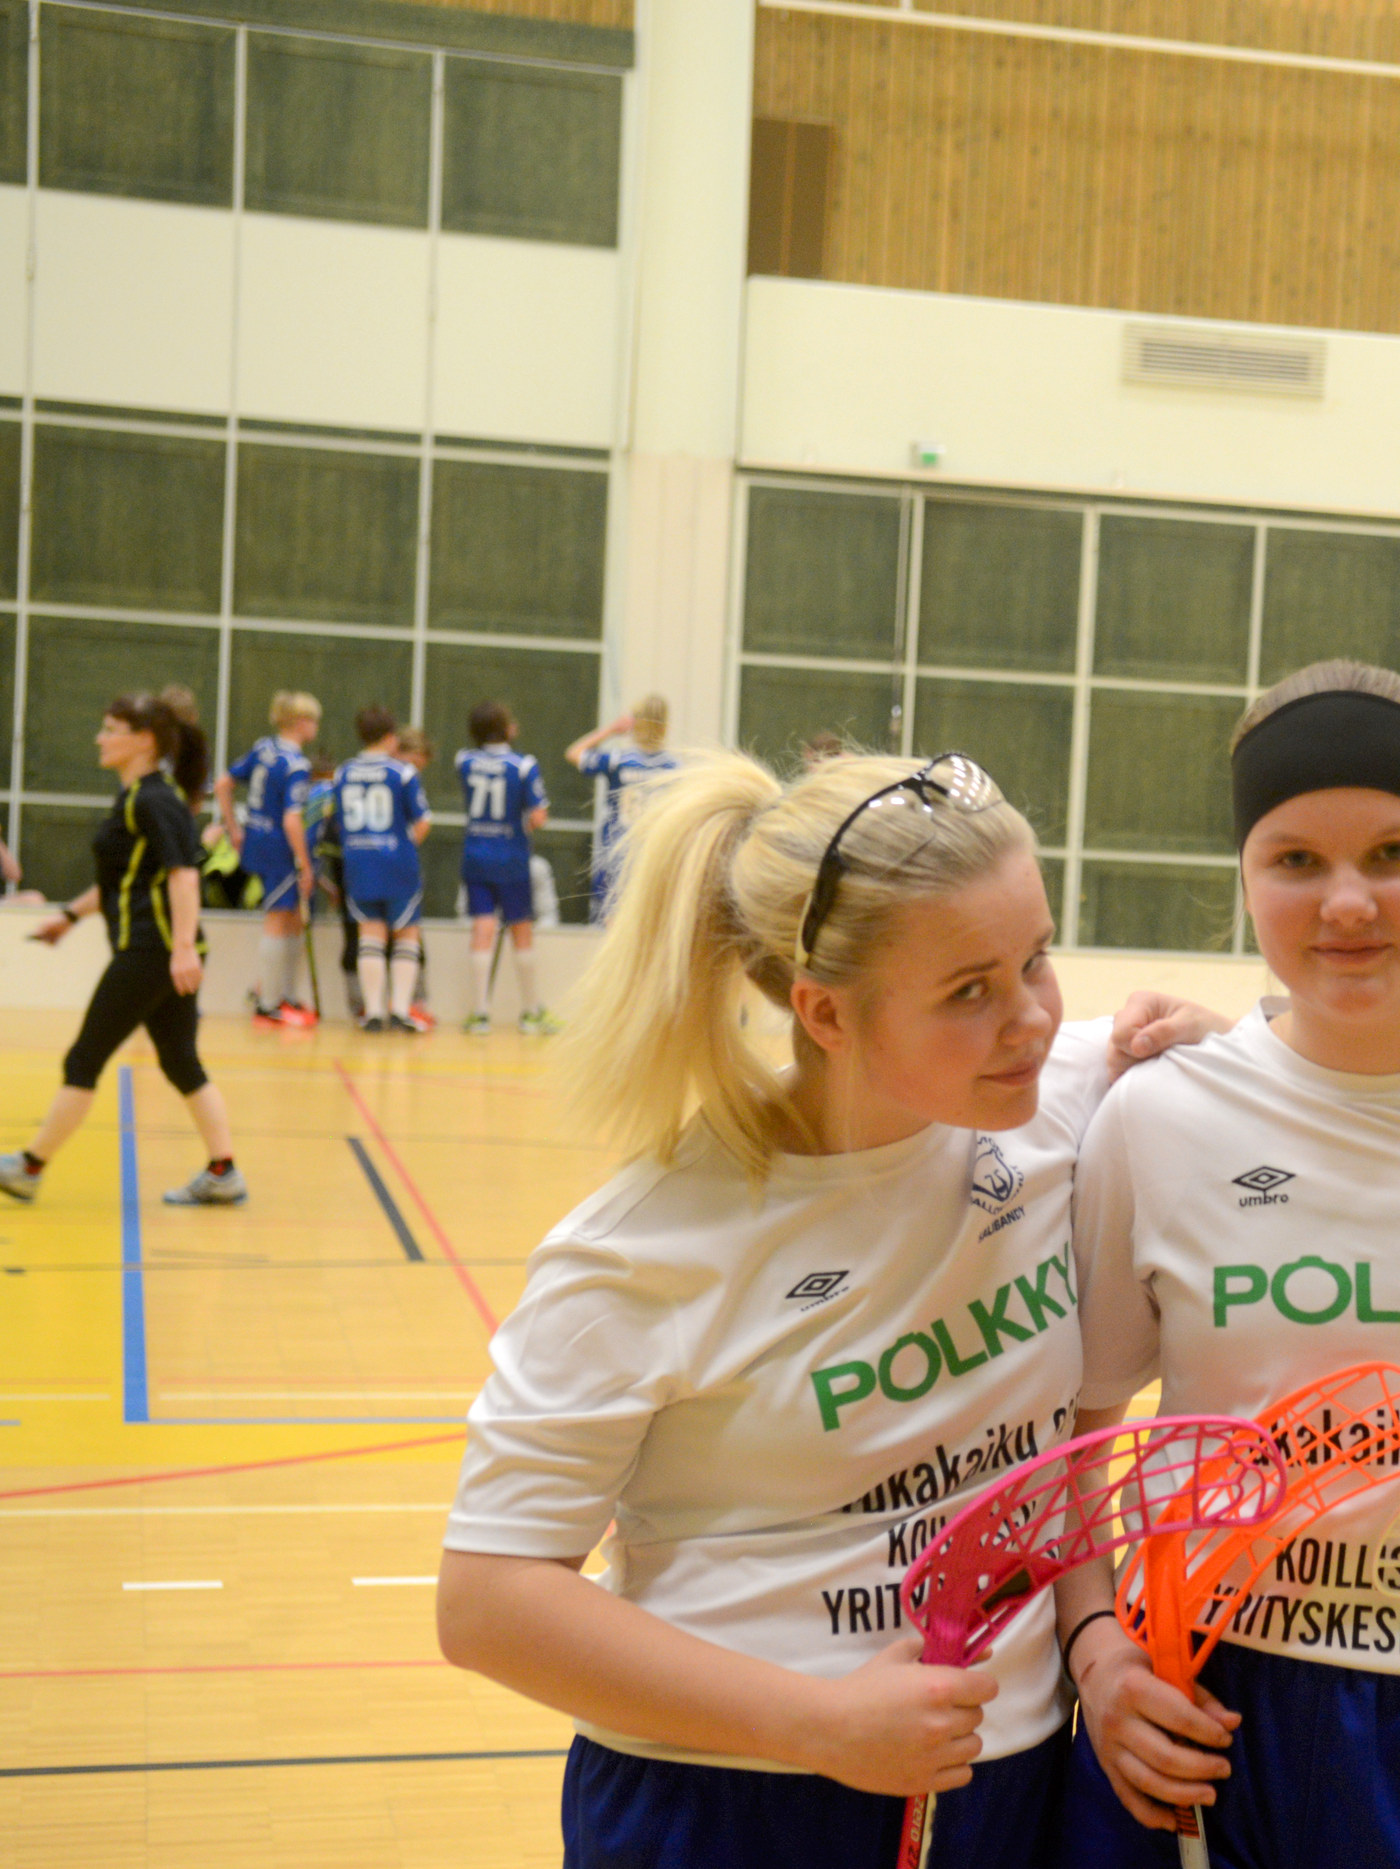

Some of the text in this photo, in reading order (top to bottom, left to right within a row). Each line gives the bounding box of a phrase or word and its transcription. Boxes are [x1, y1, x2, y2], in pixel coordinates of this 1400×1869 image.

[341, 784, 394, 833] 50
[467, 774, 507, 820] 71
[1239, 1191, 1290, 1208] umbro
